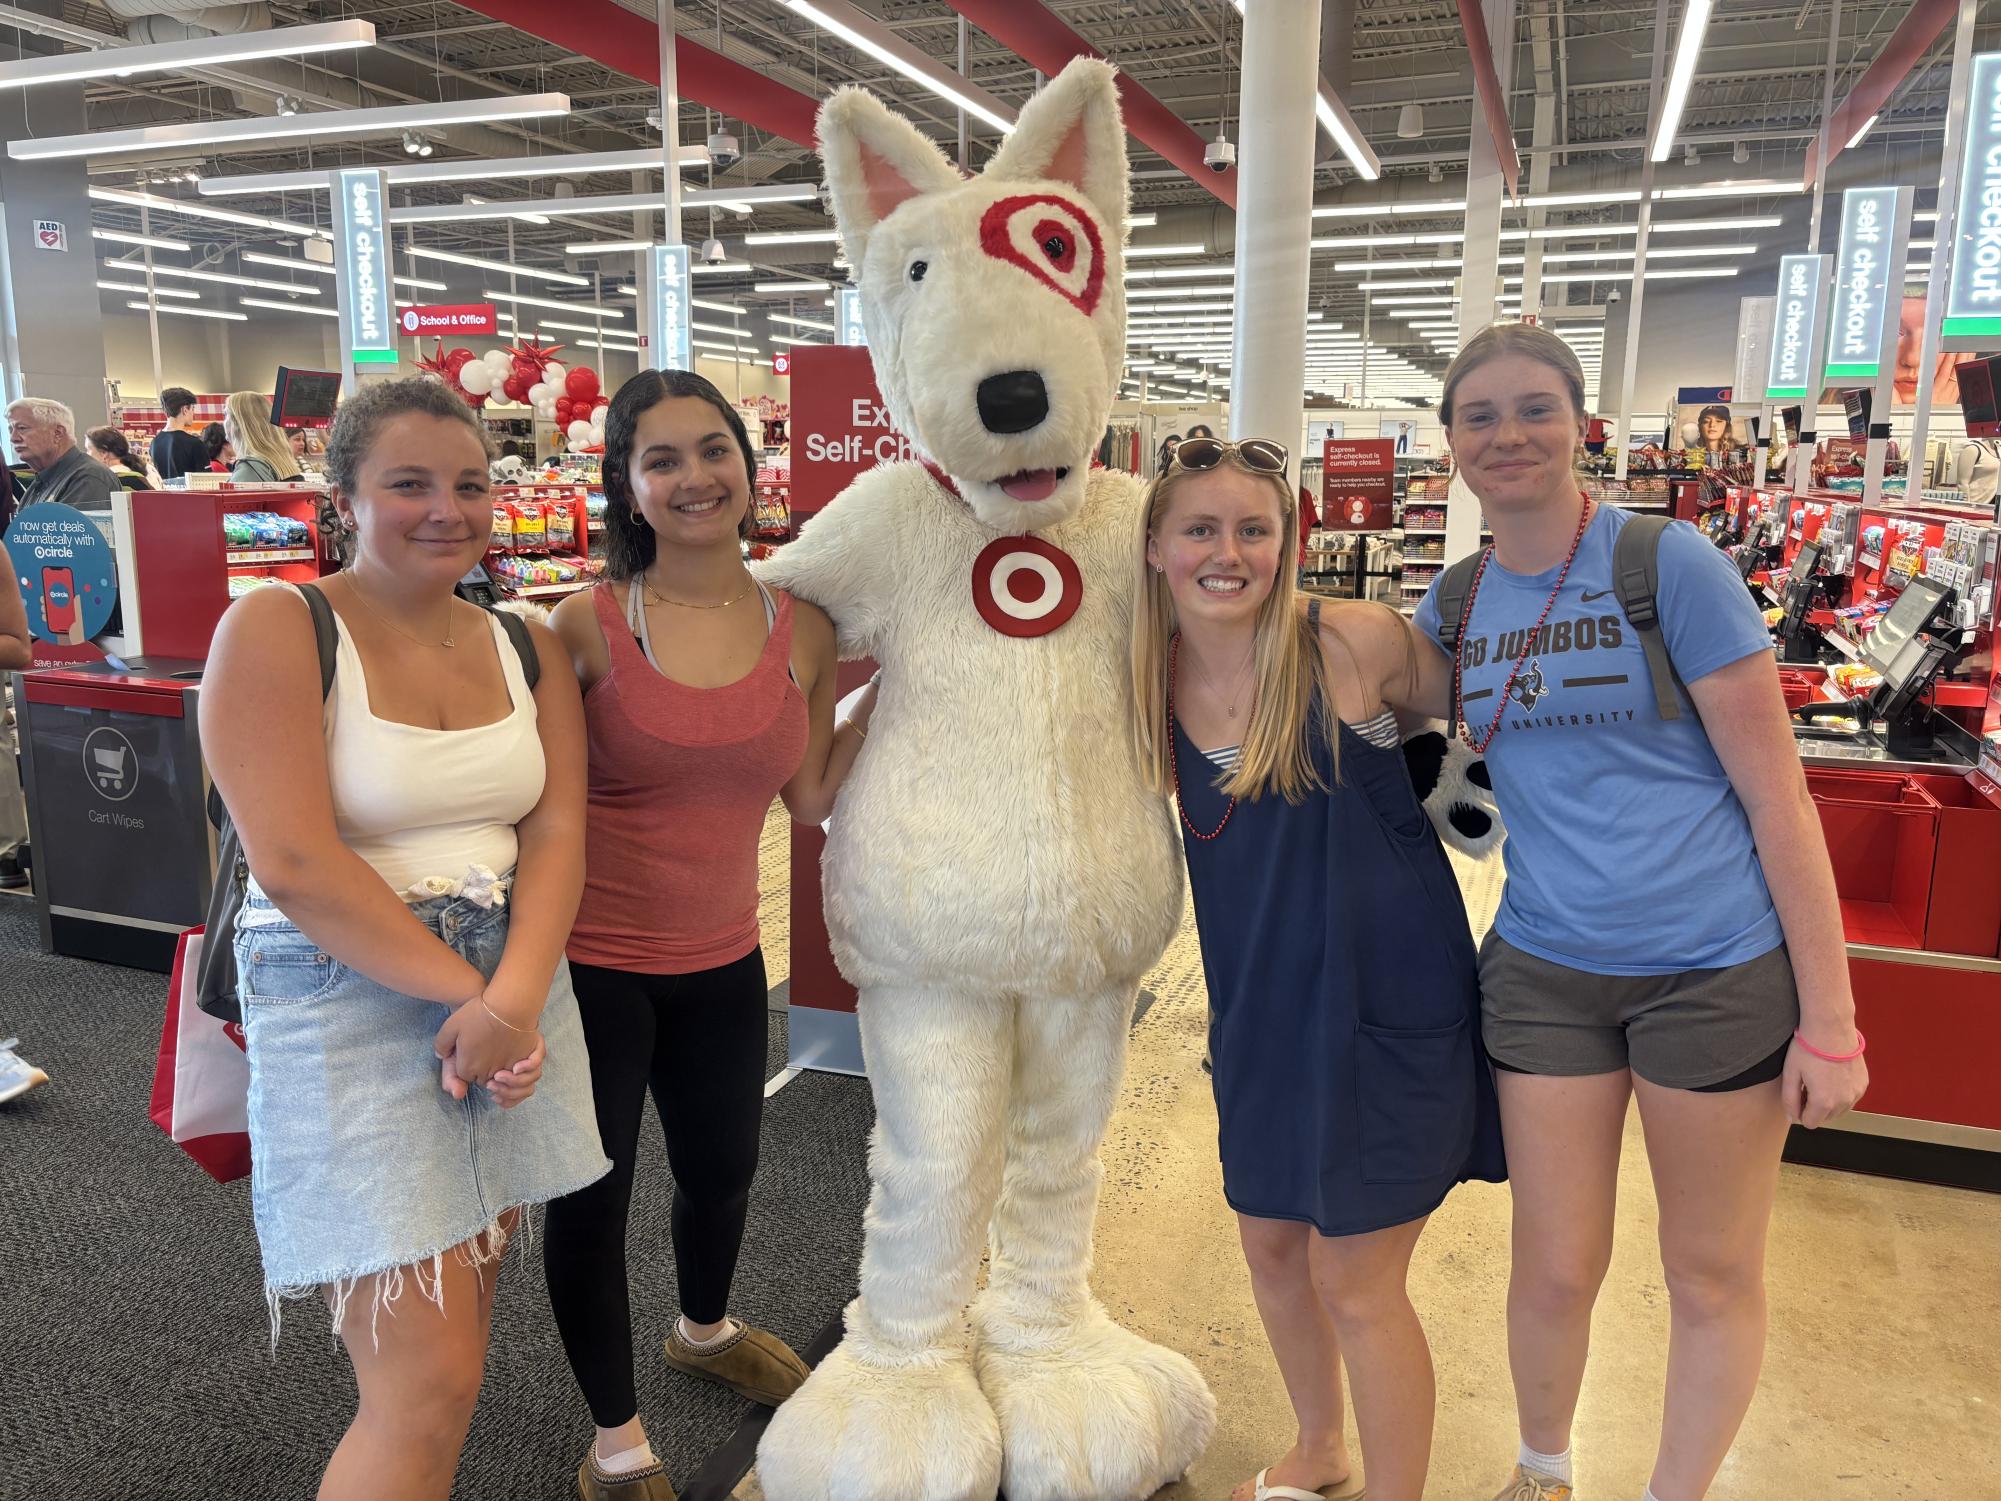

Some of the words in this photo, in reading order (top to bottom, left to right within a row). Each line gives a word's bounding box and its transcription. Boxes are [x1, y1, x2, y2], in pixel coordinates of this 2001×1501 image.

[353, 181, 373, 226] self
[39, 222, 58, 231] AED
[1855, 199, 1880, 243] self
[356, 232, 380, 340] checkout
[1789, 263, 1808, 296] self
[1844, 248, 1876, 355] checkout
[420, 315, 450, 326] School
[451, 315, 459, 325] &
[459, 314, 487, 325] Office
[1780, 300, 1805, 381] checkout
[805, 433, 914, 463] Self-Ch
[19, 521, 40, 531] now
[41, 520, 58, 534] get
[59, 520, 86, 532] deals
[13, 533, 73, 547] automatically
[74, 533, 95, 546] with
[44, 546, 73, 558] circle
[1463, 637, 1488, 671] GO
[1491, 615, 1623, 663] JUMBOS
[33, 659, 52, 667] save
[1512, 710, 1634, 730] UNIVERSITY
[88, 809, 110, 824] Cart
[111, 812, 145, 829] Wipes
